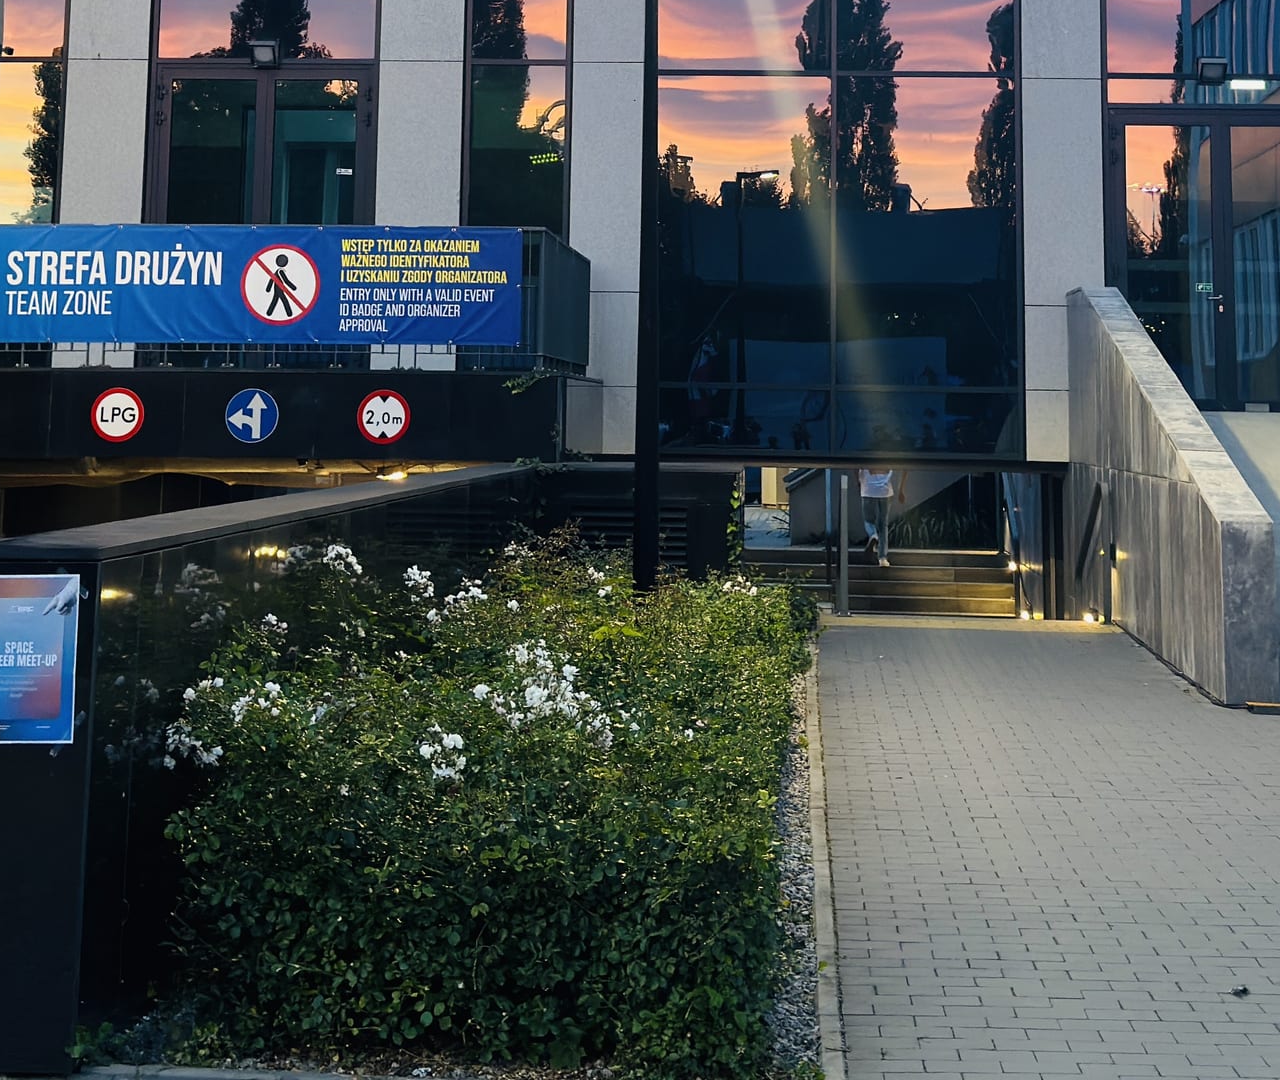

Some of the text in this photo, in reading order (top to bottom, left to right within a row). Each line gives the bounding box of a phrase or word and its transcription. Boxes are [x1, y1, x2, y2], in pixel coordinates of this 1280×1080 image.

[341, 239, 480, 254] WSTĘP TYLKO ZA OKAZANIEM
[6, 243, 223, 286] STREFA DRUŻYN
[389, 255, 470, 268] IDENTYFIKATORA
[340, 270, 508, 284] I UZYSKANIU ZGODY ORGANIZATORA
[340, 288, 495, 303] ENTRY ONLY WITH A VALID EVENT
[5, 290, 113, 316] TEAM ZONE
[339, 303, 461, 317] ID BADGE AND ORGANIZER
[338, 319, 388, 332] APPROVAL
[100, 406, 136, 423] LPG
[4, 641, 35, 654] SPACE
[17, 653, 58, 667] MEET-UP
